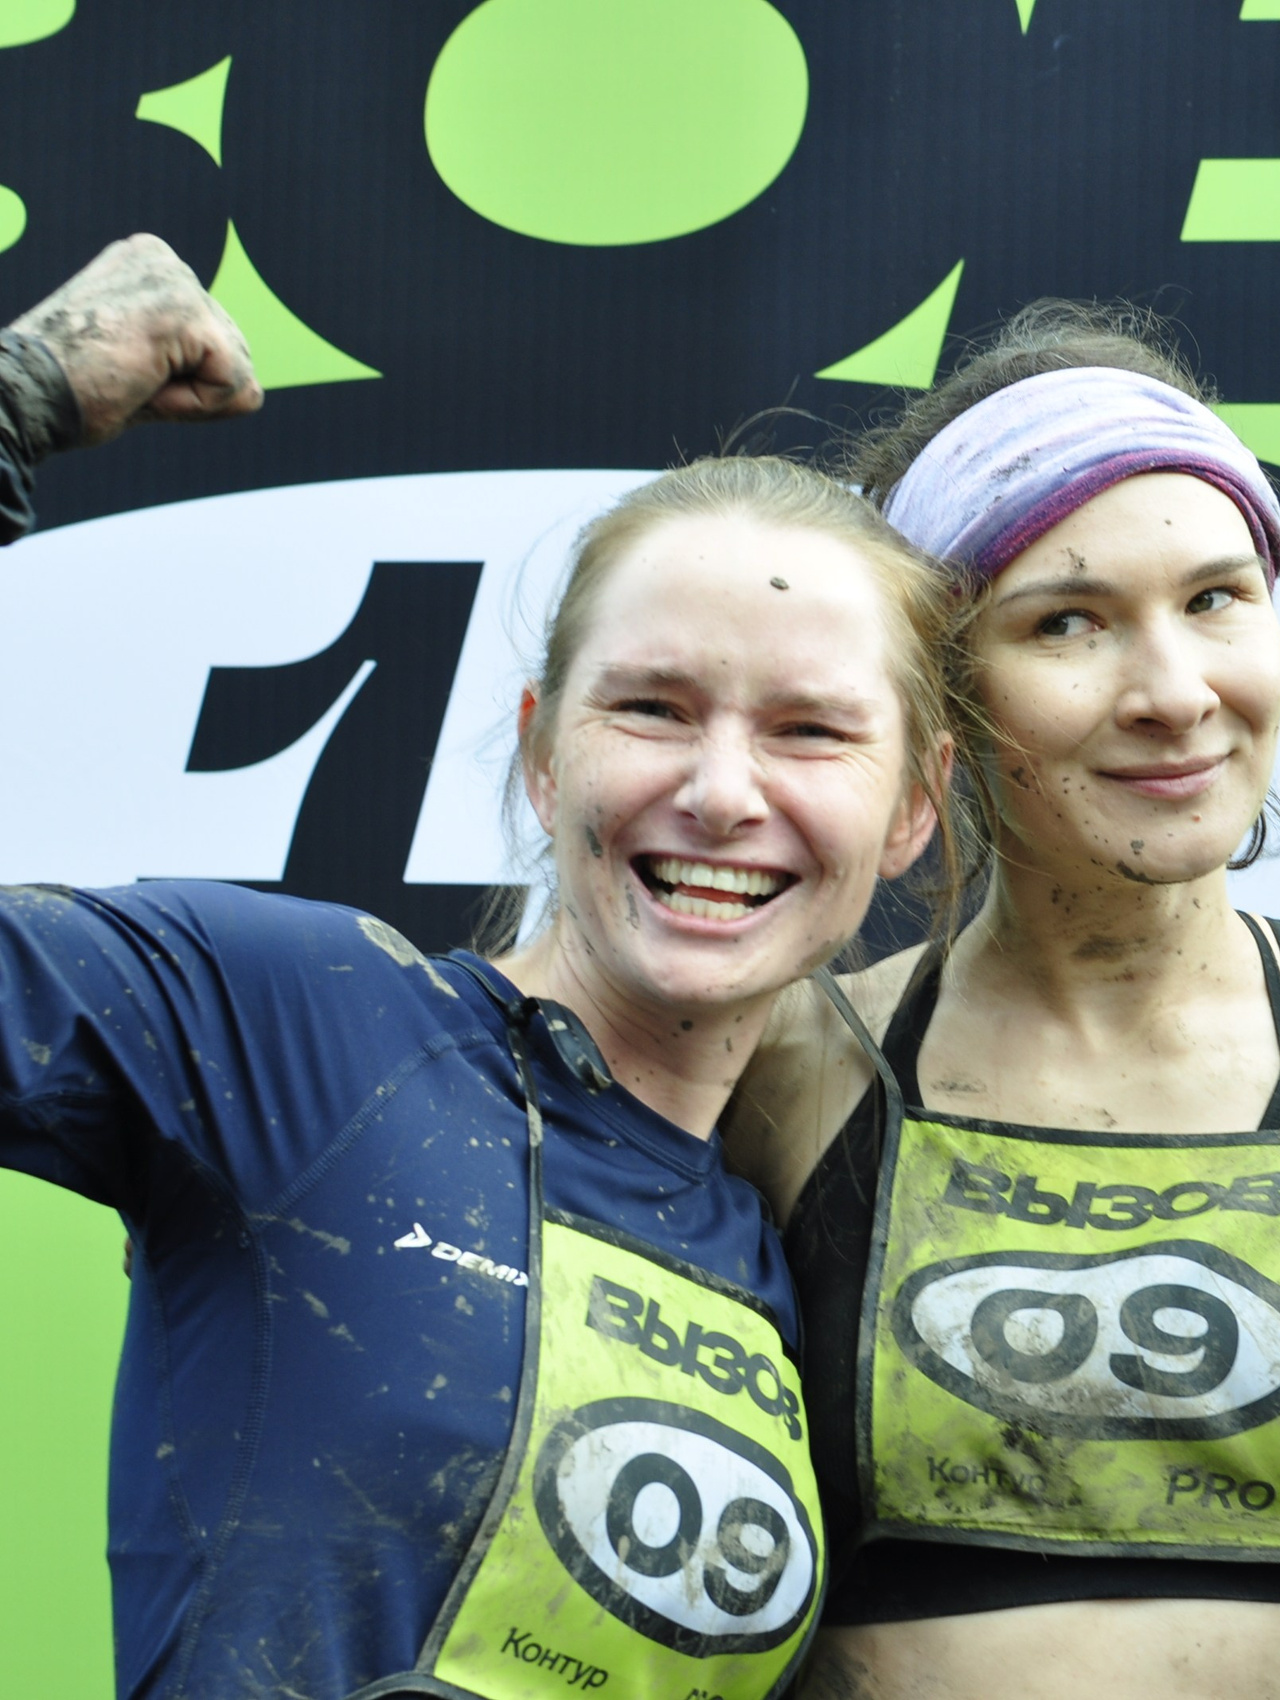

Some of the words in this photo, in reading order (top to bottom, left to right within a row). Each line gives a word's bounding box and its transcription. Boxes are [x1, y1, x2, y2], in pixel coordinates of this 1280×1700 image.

[970, 1284, 1239, 1398] 09
[1166, 1466, 1276, 1511] PRO
[605, 1452, 790, 1616] 09
[500, 1627, 609, 1691] Контур
